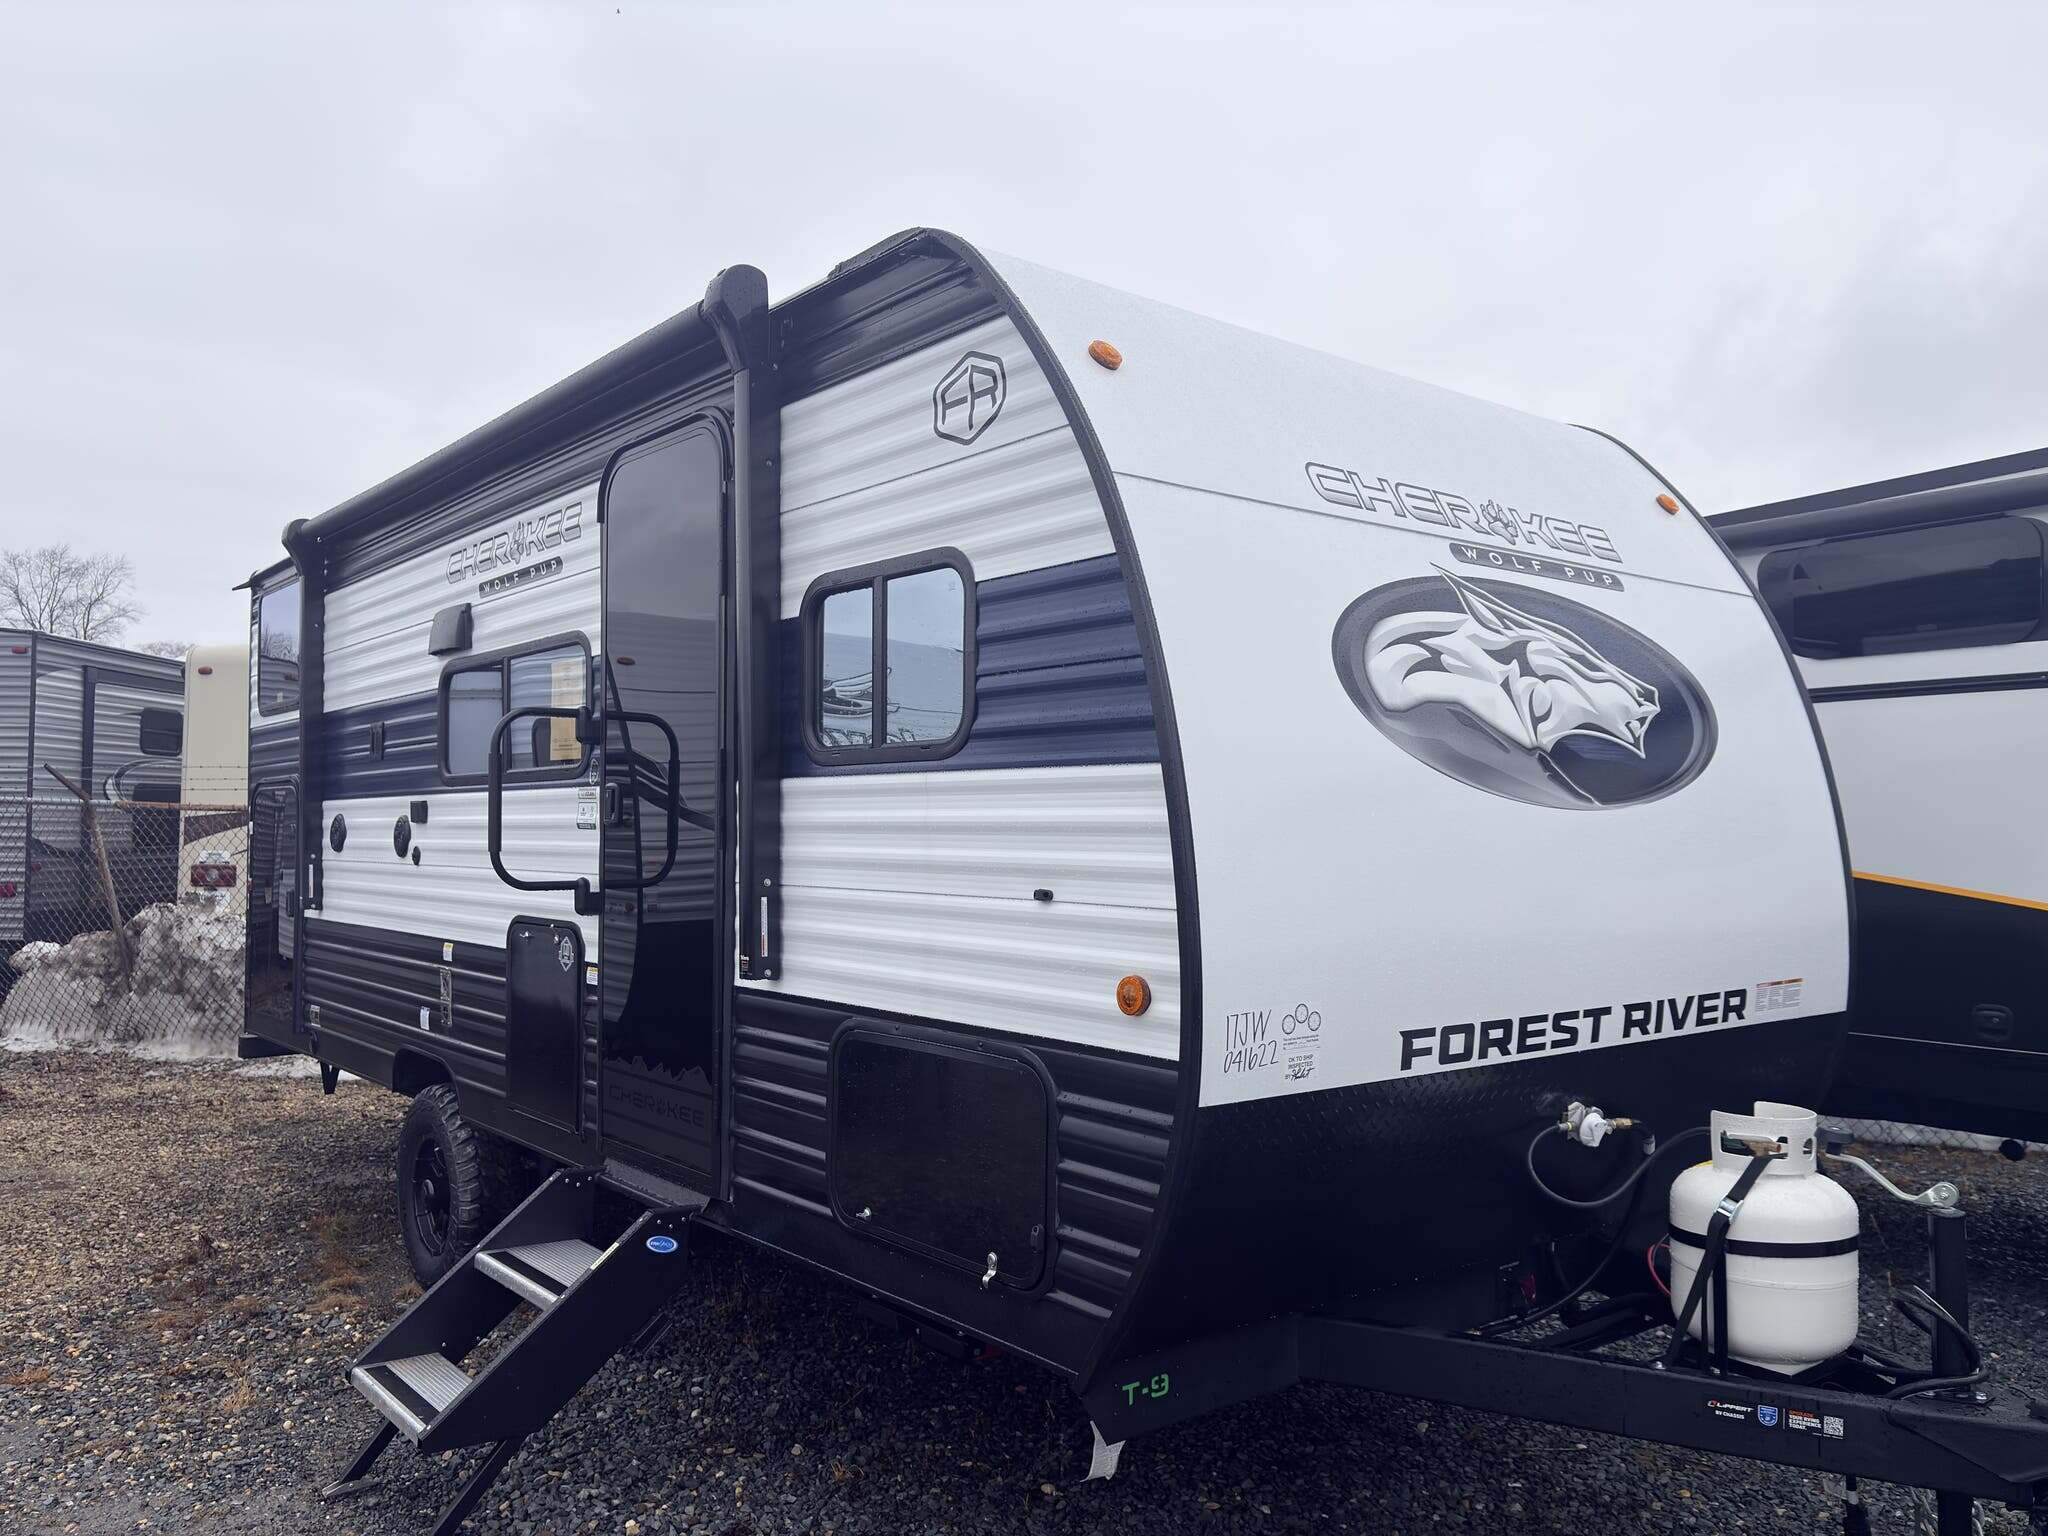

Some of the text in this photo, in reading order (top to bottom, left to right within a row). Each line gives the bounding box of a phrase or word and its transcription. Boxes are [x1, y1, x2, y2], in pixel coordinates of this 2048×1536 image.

[483, 561, 557, 593] WOLF PUP
[1461, 546, 1614, 586] WOLF PUP
[1225, 1009, 1272, 1051] 17JW
[1399, 1006, 1613, 1071] FOREST
[1622, 988, 1748, 1039] RIVER
[1223, 1040, 1279, 1074] 041622
